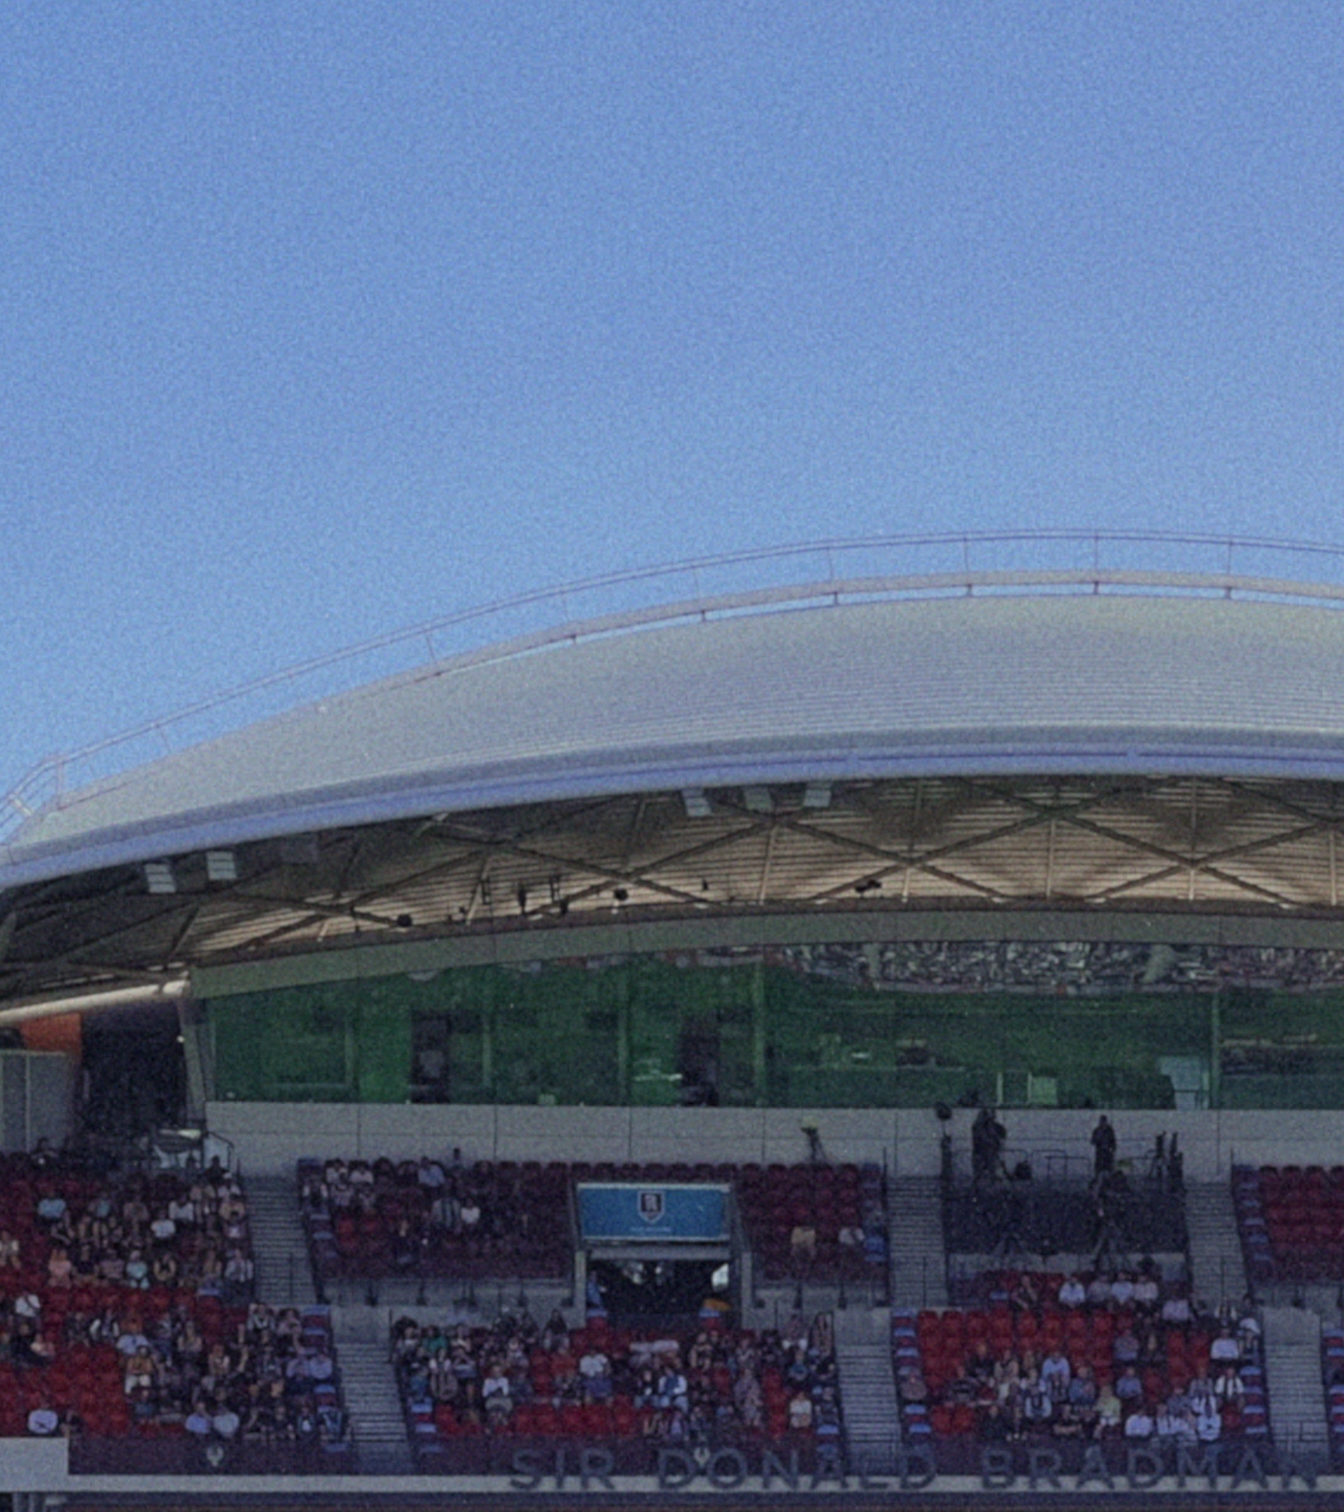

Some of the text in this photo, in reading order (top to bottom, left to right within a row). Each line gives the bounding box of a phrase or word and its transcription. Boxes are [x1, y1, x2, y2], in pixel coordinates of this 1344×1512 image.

[510, 1448, 614, 1490] SIR
[657, 1447, 938, 1491] DONALD
[981, 1446, 1321, 1490] BRADMAN
